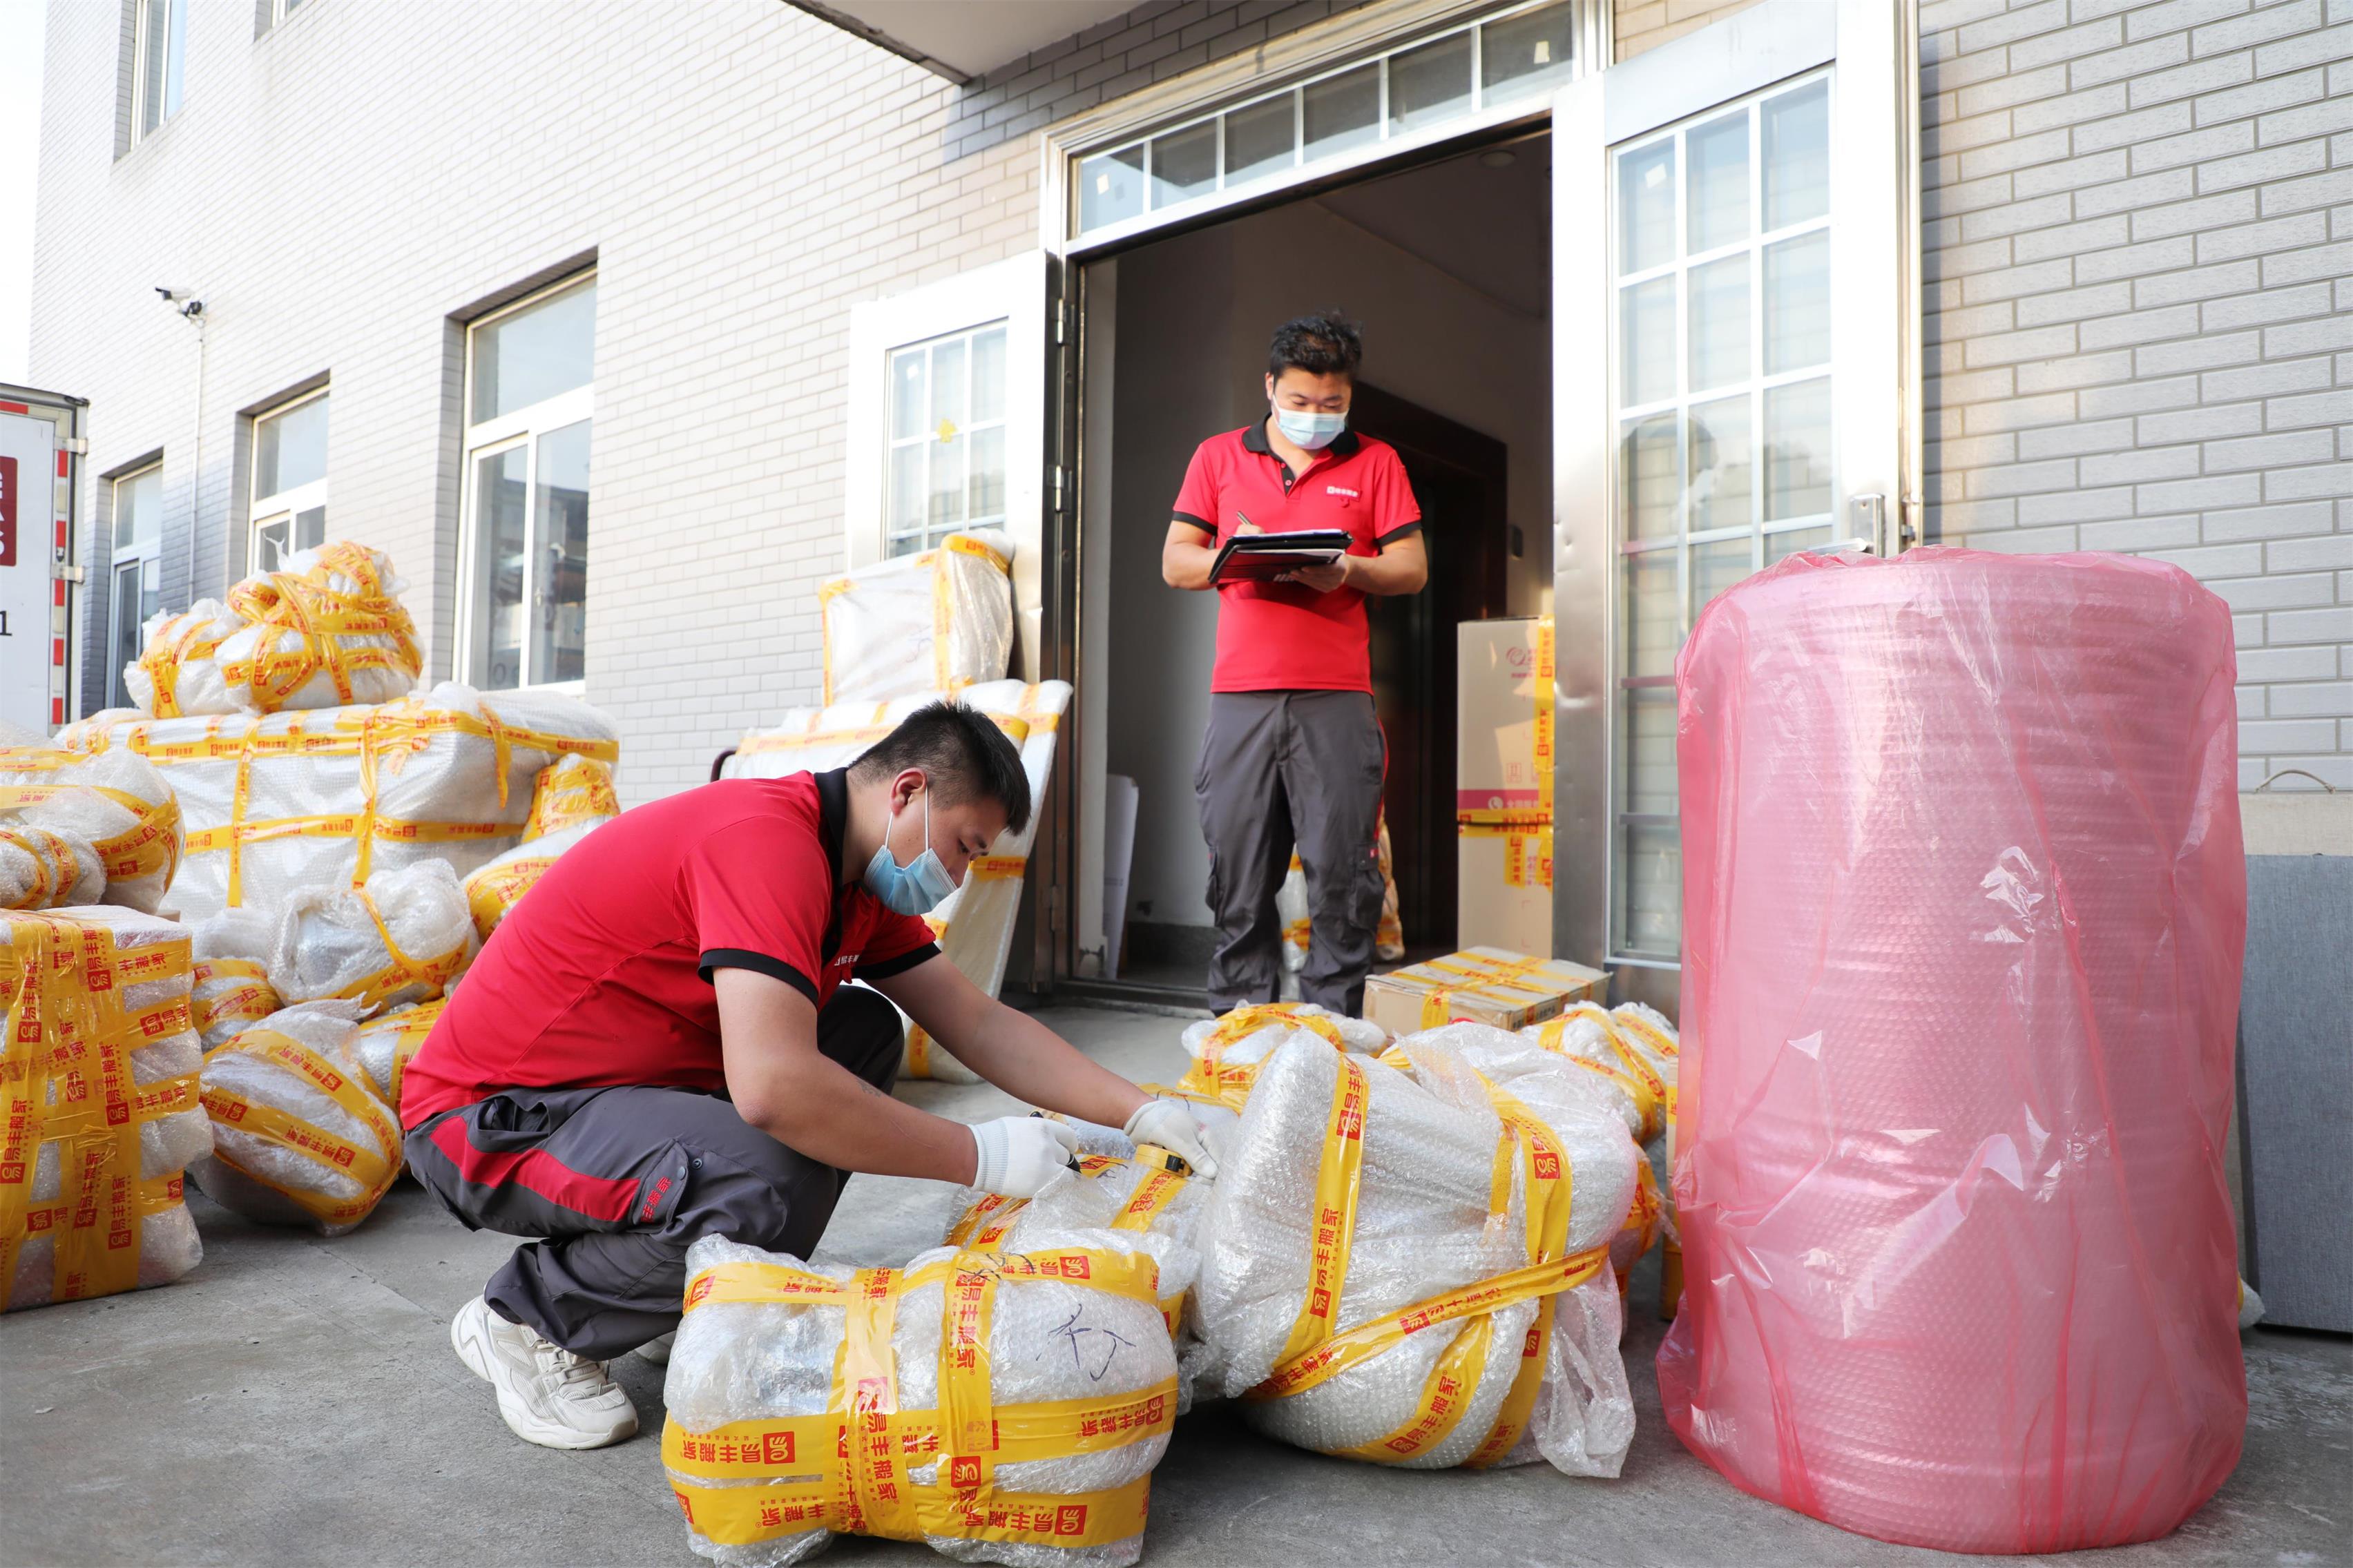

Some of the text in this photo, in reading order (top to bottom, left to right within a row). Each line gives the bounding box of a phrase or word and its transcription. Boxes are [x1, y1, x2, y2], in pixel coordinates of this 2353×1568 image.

[99, 1043, 122, 1104] 易丰搬家
[3, 1099, 27, 1161] 易丰搬家
[285, 1127, 336, 1158] 易丰搬家
[111, 1176, 126, 1231] 易丰搬家
[1316, 1208, 1338, 1288] 易丰搬家
[957, 1287, 981, 1369] 易丰搬家
[1080, 1409, 1146, 1438] 易丰搬家
[1406, 1375, 1456, 1442] 易丰搬家
[682, 1440, 760, 1463] 易丰搬家
[867, 1413, 897, 1501] 易丰搬家
